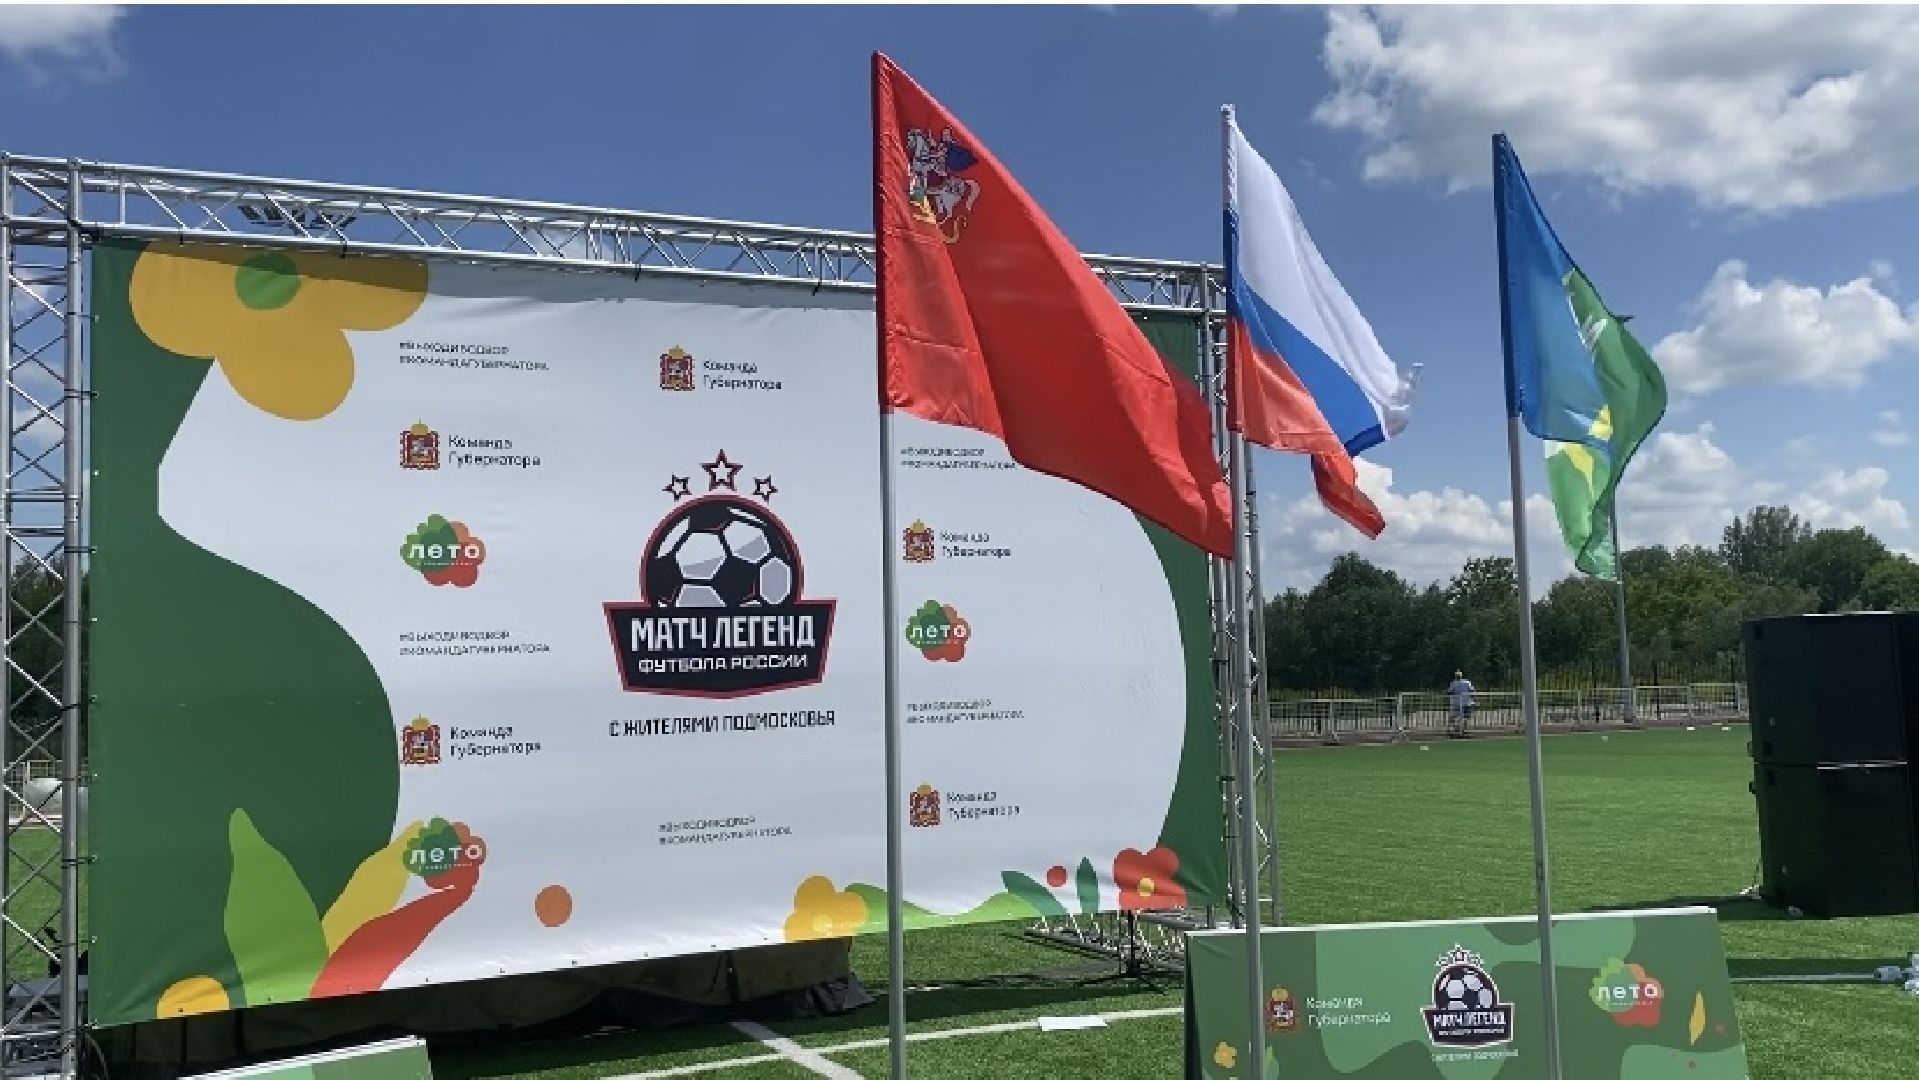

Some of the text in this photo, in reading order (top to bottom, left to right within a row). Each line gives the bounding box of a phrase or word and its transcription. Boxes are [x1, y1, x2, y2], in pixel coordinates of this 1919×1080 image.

[703, 359, 758, 375] Команда
[703, 374, 783, 391] Губернатора
[448, 434, 513, 450] Команда
[448, 450, 541, 468] Губернатора
[631, 615, 816, 652] МАТЧ ЛЕГЕНД
[638, 653, 807, 674] ФУТБОЛА РОССИИ
[608, 710, 835, 737] С ЖИТЕЛЯМИ ПОДМОСКОВЬЯ
[450, 726, 513, 740] Команда
[450, 742, 541, 761] Губернатора
